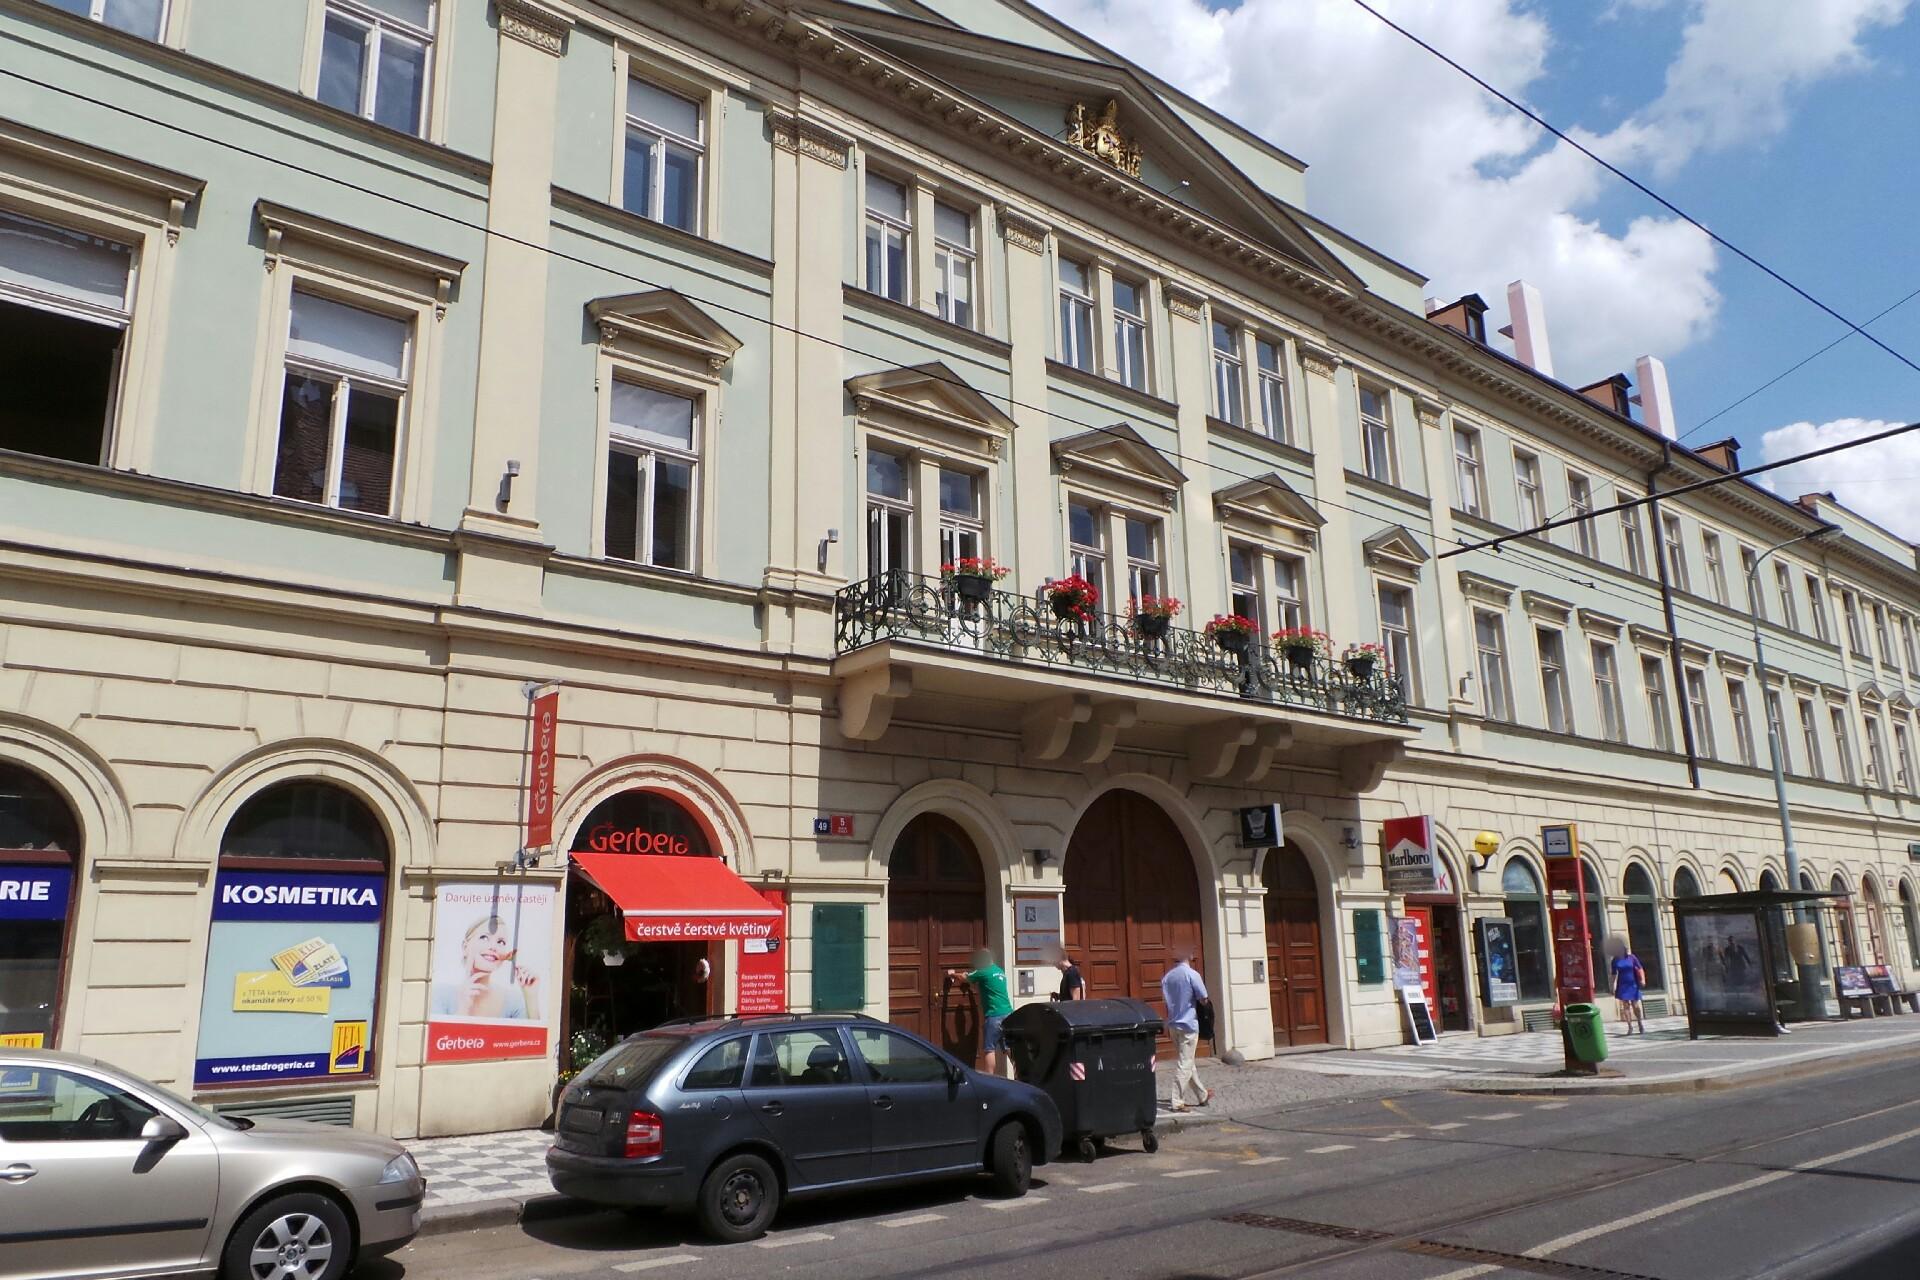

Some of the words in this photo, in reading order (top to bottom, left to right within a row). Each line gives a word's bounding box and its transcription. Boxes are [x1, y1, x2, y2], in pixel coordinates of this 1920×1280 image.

[535, 711, 551, 815] Gerbera
[818, 822, 828, 831] 49
[840, 817, 846, 827] 5
[590, 821, 690, 855] Gerbera
[1388, 849, 1430, 867] Marlboro
[0, 880, 51, 901] RIE
[222, 884, 378, 906] KOSMETIKA
[445, 892, 482, 905] Darujte
[637, 922, 680, 937] čerstvě
[684, 922, 727, 937] čerstvé
[729, 922, 771, 940] květiny
[336, 1025, 362, 1055] TETA
[437, 1035, 485, 1051] Gerbera
[211, 1060, 316, 1074] www.tetadrogerie.cz
